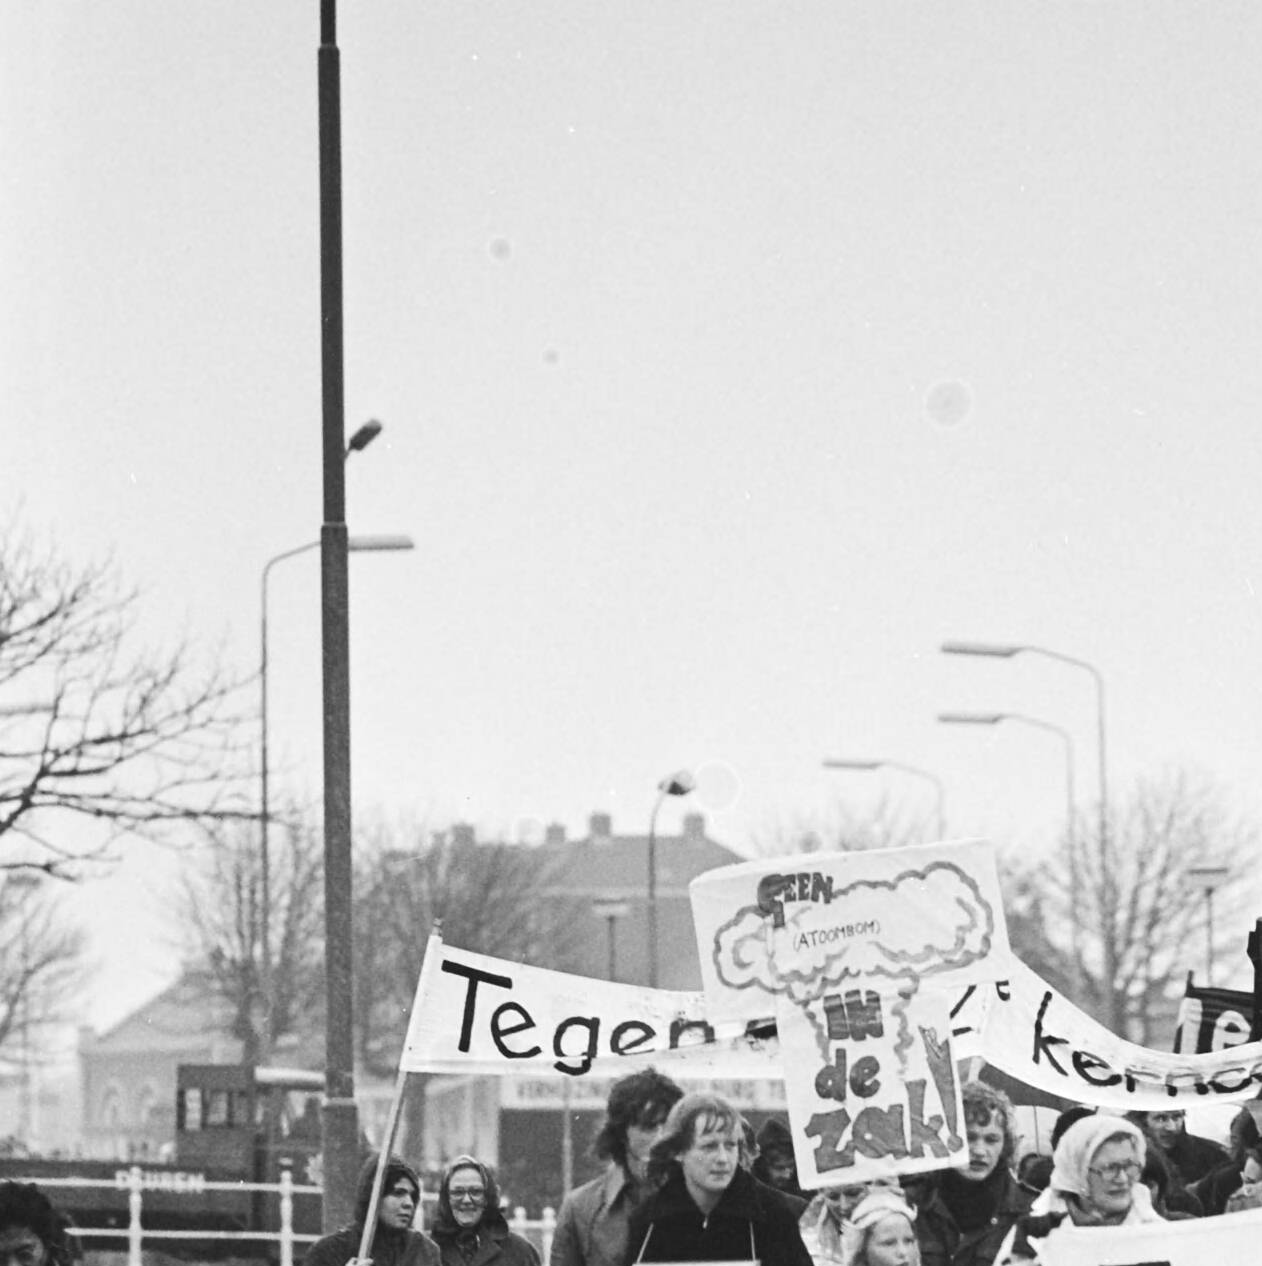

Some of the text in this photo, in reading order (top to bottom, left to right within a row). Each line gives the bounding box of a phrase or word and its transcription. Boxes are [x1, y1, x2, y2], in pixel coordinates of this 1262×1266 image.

[758, 872, 834, 928] GEEN
[793, 919, 880, 952] (ATOOMBOM)
[441, 959, 715, 1076] Tegen
[815, 1048, 881, 1103] de
